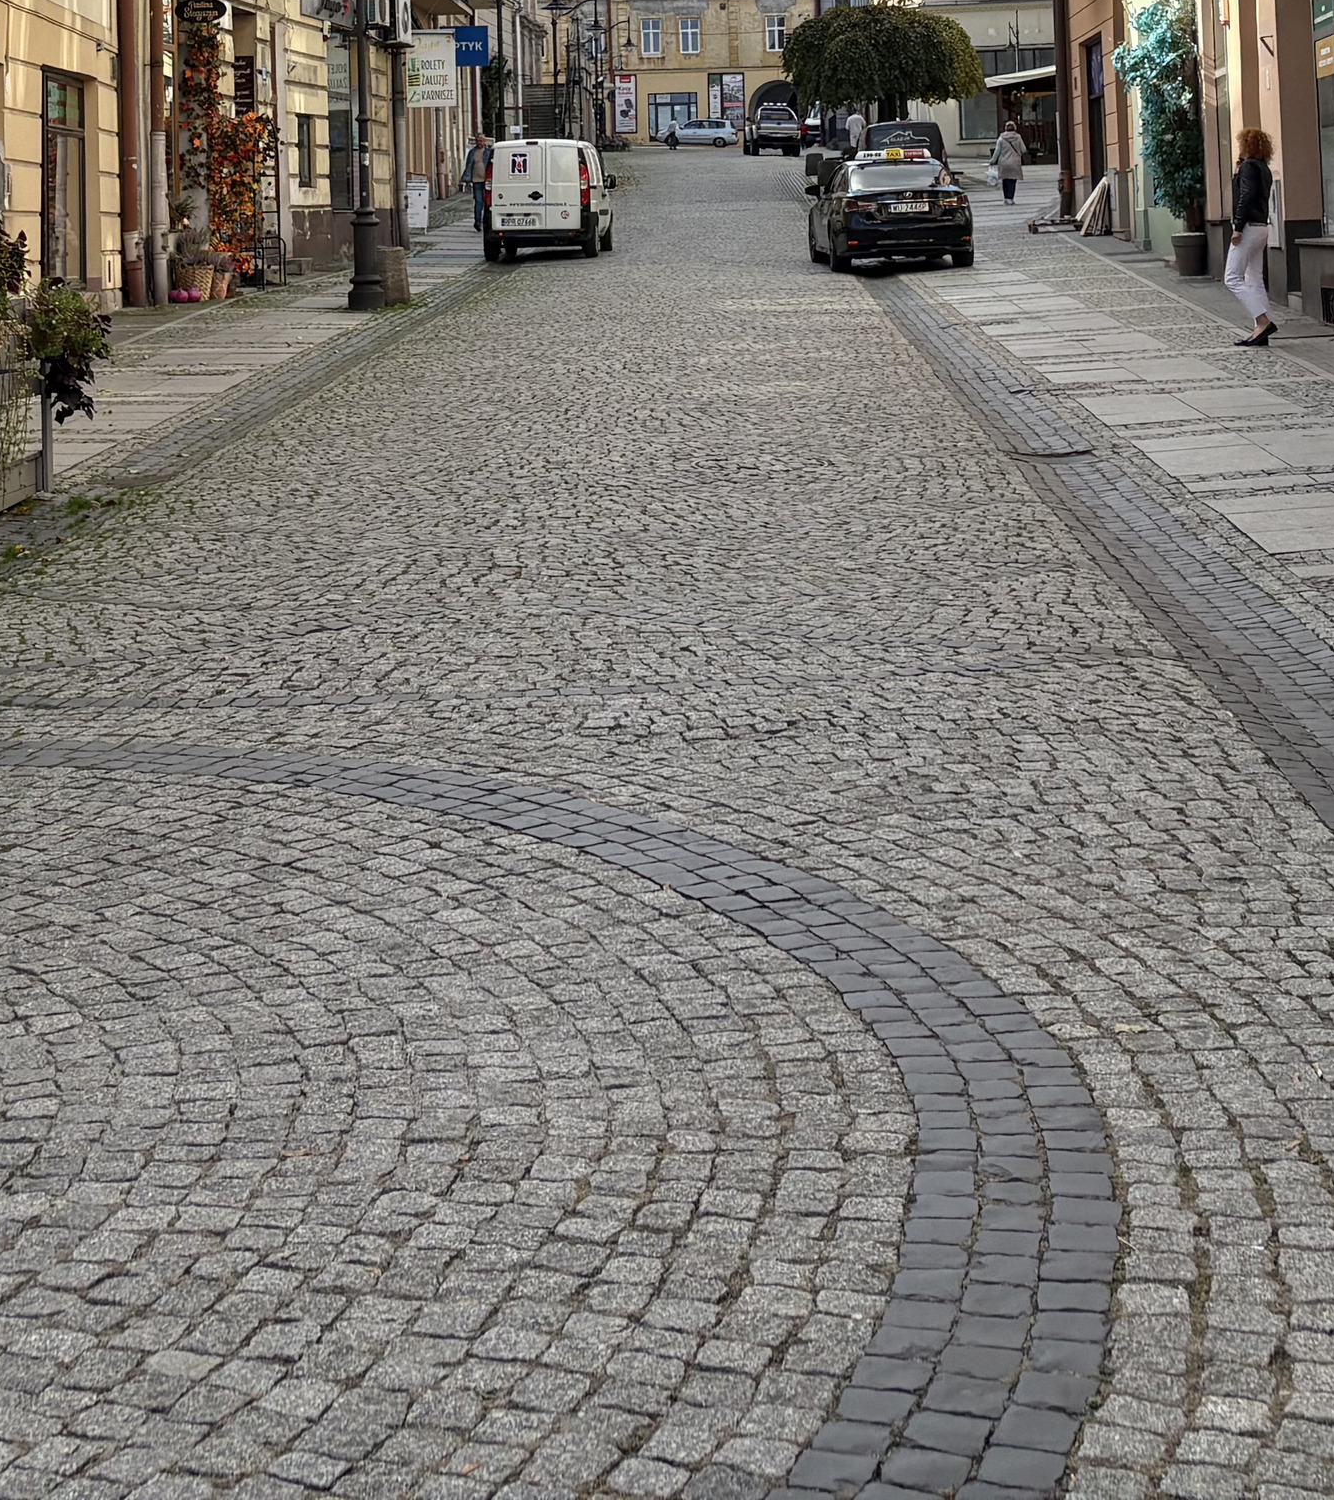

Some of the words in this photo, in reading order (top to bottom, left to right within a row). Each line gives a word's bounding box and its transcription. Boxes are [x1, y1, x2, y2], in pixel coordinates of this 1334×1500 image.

[455, 41, 483, 51] PTYK
[421, 59, 445, 70] ROLETY
[421, 73, 449, 87] ŻALUZJE
[421, 89, 455, 101] KARNISZE
[886, 149, 901, 158] TAXI
